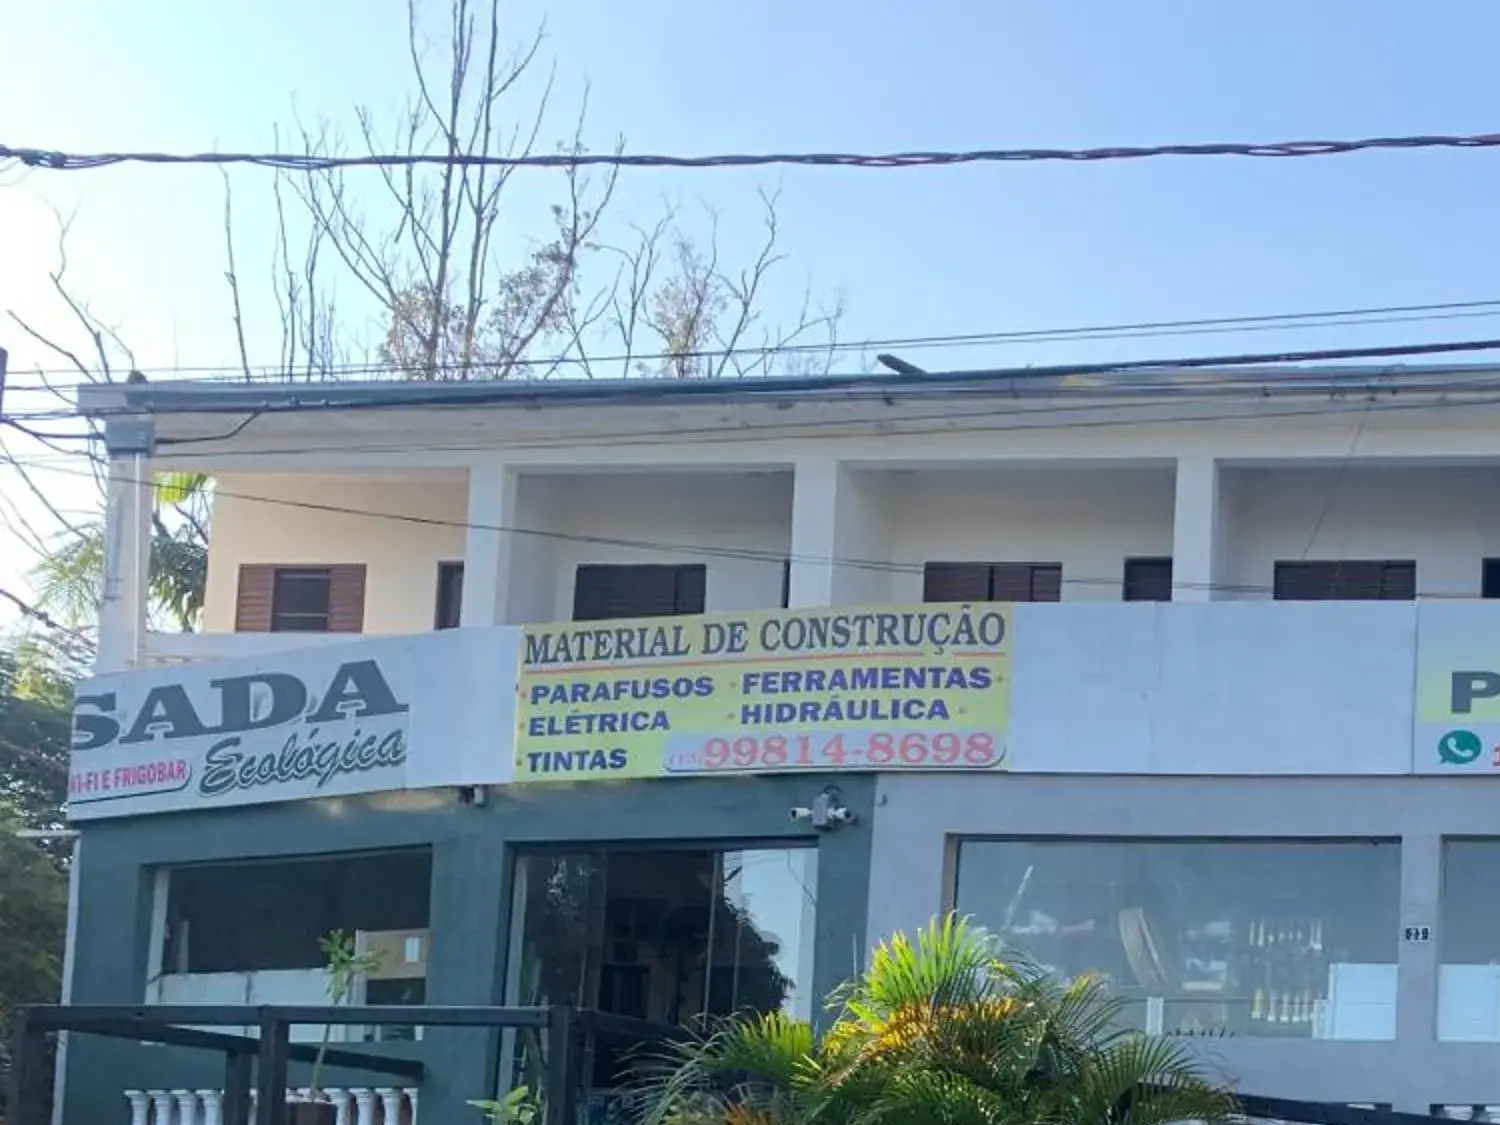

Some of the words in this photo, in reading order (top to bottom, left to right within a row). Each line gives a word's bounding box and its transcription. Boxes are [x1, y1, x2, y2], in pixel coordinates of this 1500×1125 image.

[523, 624, 691, 666] MATERIAL
[702, 620, 749, 654] DE
[760, 603, 1006, 656] CONSTRUÇÃO
[70, 658, 410, 751] SADA
[530, 675, 715, 706] PARAFUSOS
[742, 666, 993, 695] FERRAMENTAS
[528, 708, 671, 738] ELÉTRICA
[740, 692, 950, 725] HIDRÁULICA
[199, 727, 406, 796] Ecológica
[527, 747, 628, 774] TINTAS
[703, 731, 995, 768] 99814-8698
[101, 769, 112, 790] E
[114, 759, 188, 788] FRIGOBAR
